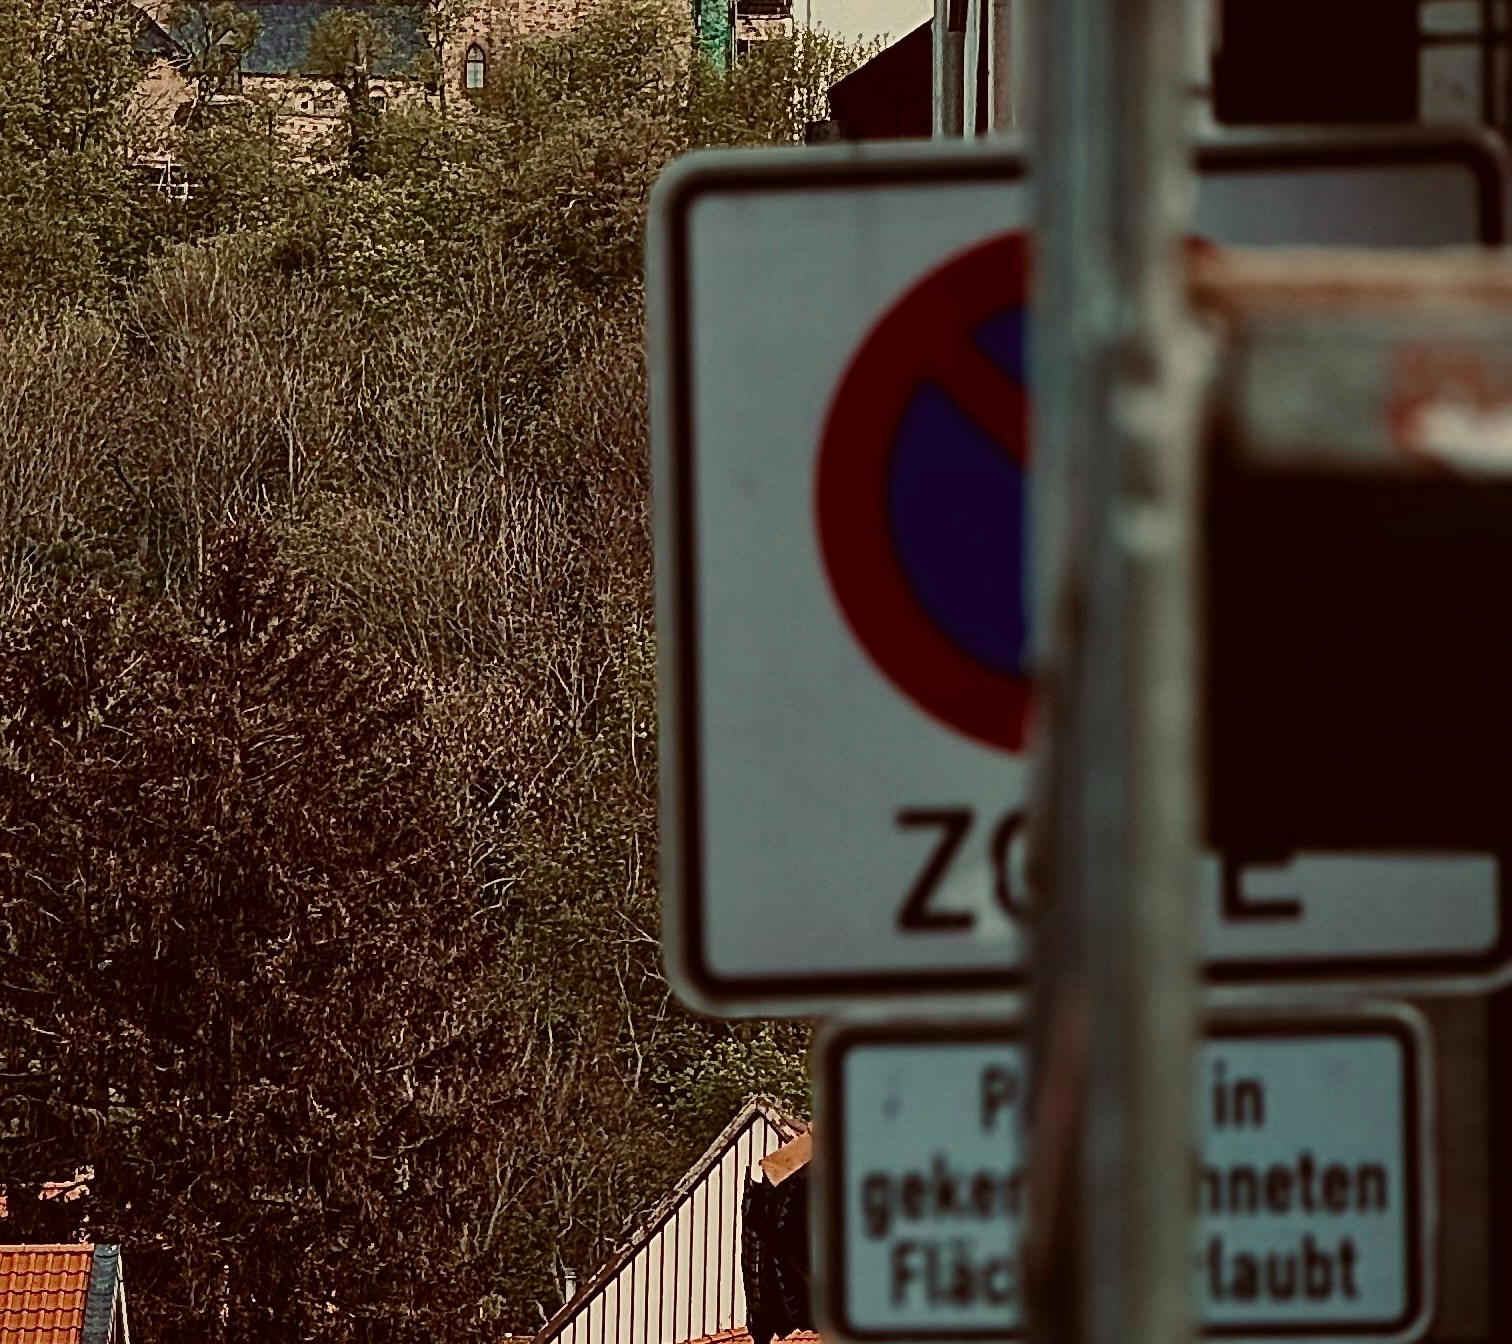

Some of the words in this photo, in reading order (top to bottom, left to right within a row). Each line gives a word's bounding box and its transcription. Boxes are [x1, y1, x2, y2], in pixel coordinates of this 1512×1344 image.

[896, 808, 1303, 930] ZOE
[1212, 1061, 1265, 1129] in
[891, 1238, 1016, 1308] Fläc
[1200, 1237, 1359, 1302] laubt
